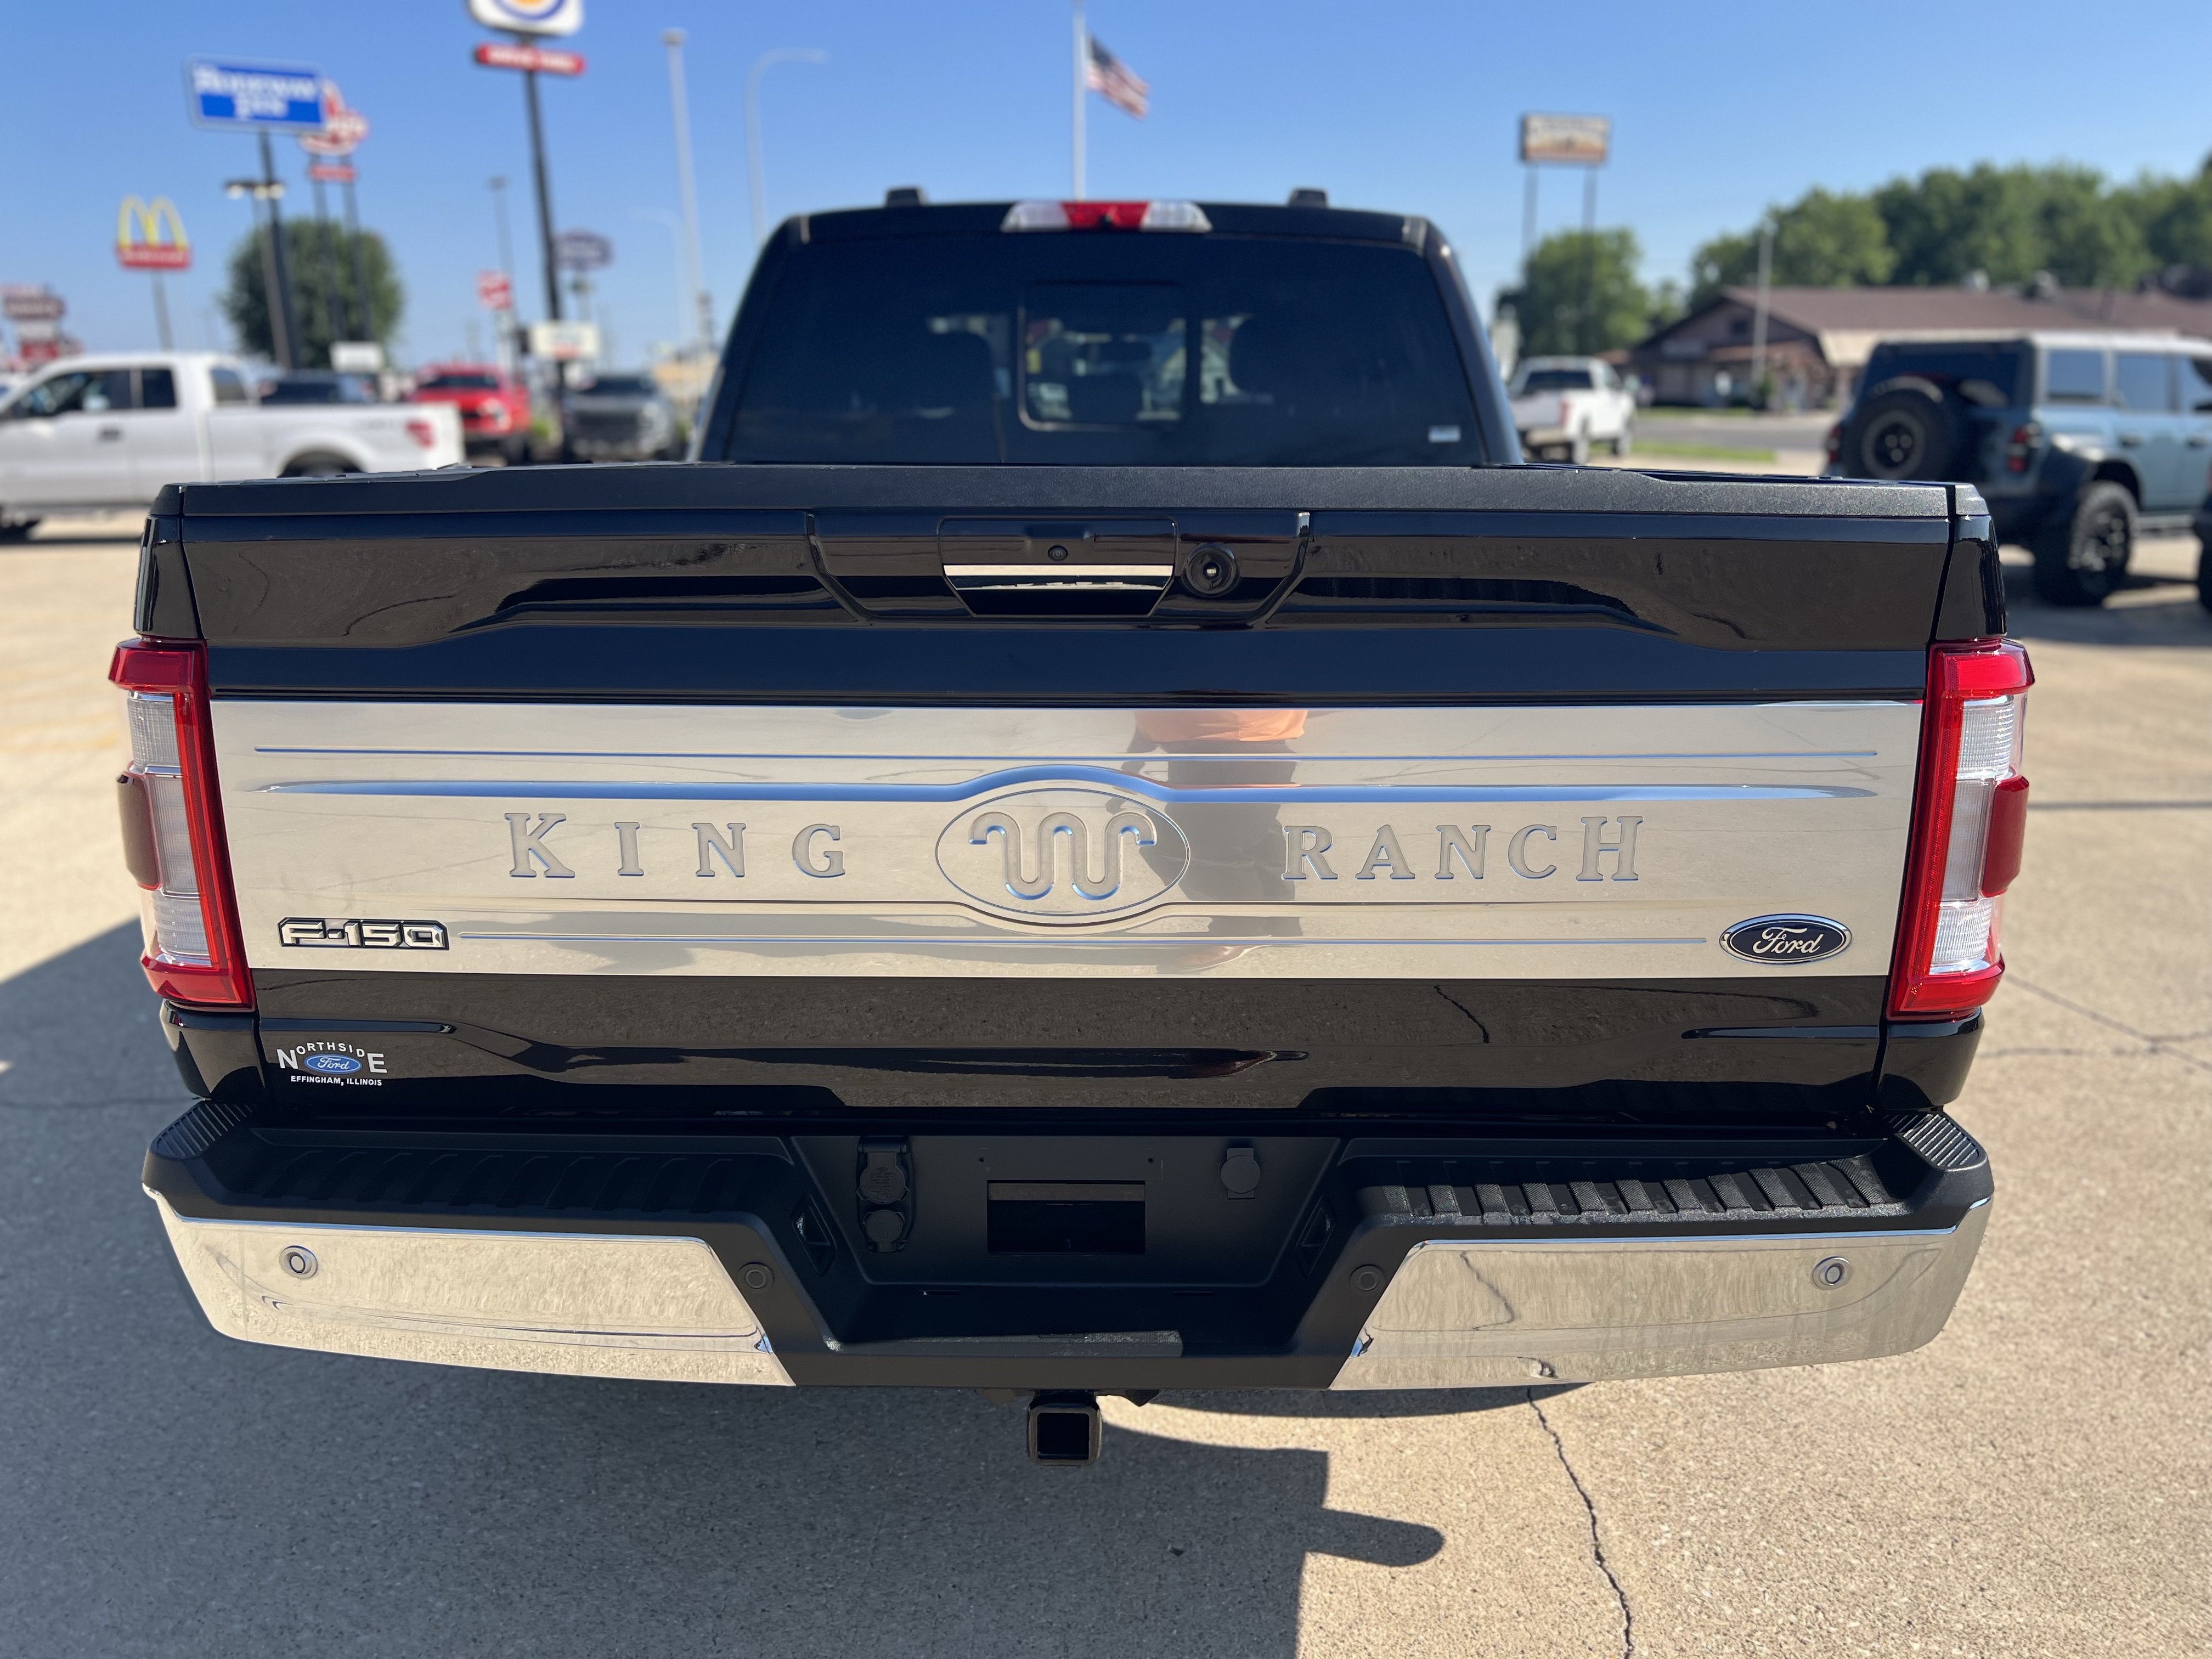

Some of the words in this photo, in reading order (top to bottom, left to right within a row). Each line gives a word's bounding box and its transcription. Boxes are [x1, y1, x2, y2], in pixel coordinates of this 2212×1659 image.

[504, 813, 846, 878] KING
[1282, 816, 1643, 882] RANCH
[278, 917, 449, 950] F-150
[1752, 926, 1824, 954] Ford
[276, 1042, 387, 1074] NORTHSIDE
[317, 1057, 350, 1070] Ford
[291, 1075, 344, 1086] EFFINGHAM,
[346, 1077, 382, 1086] ILLINOIS
